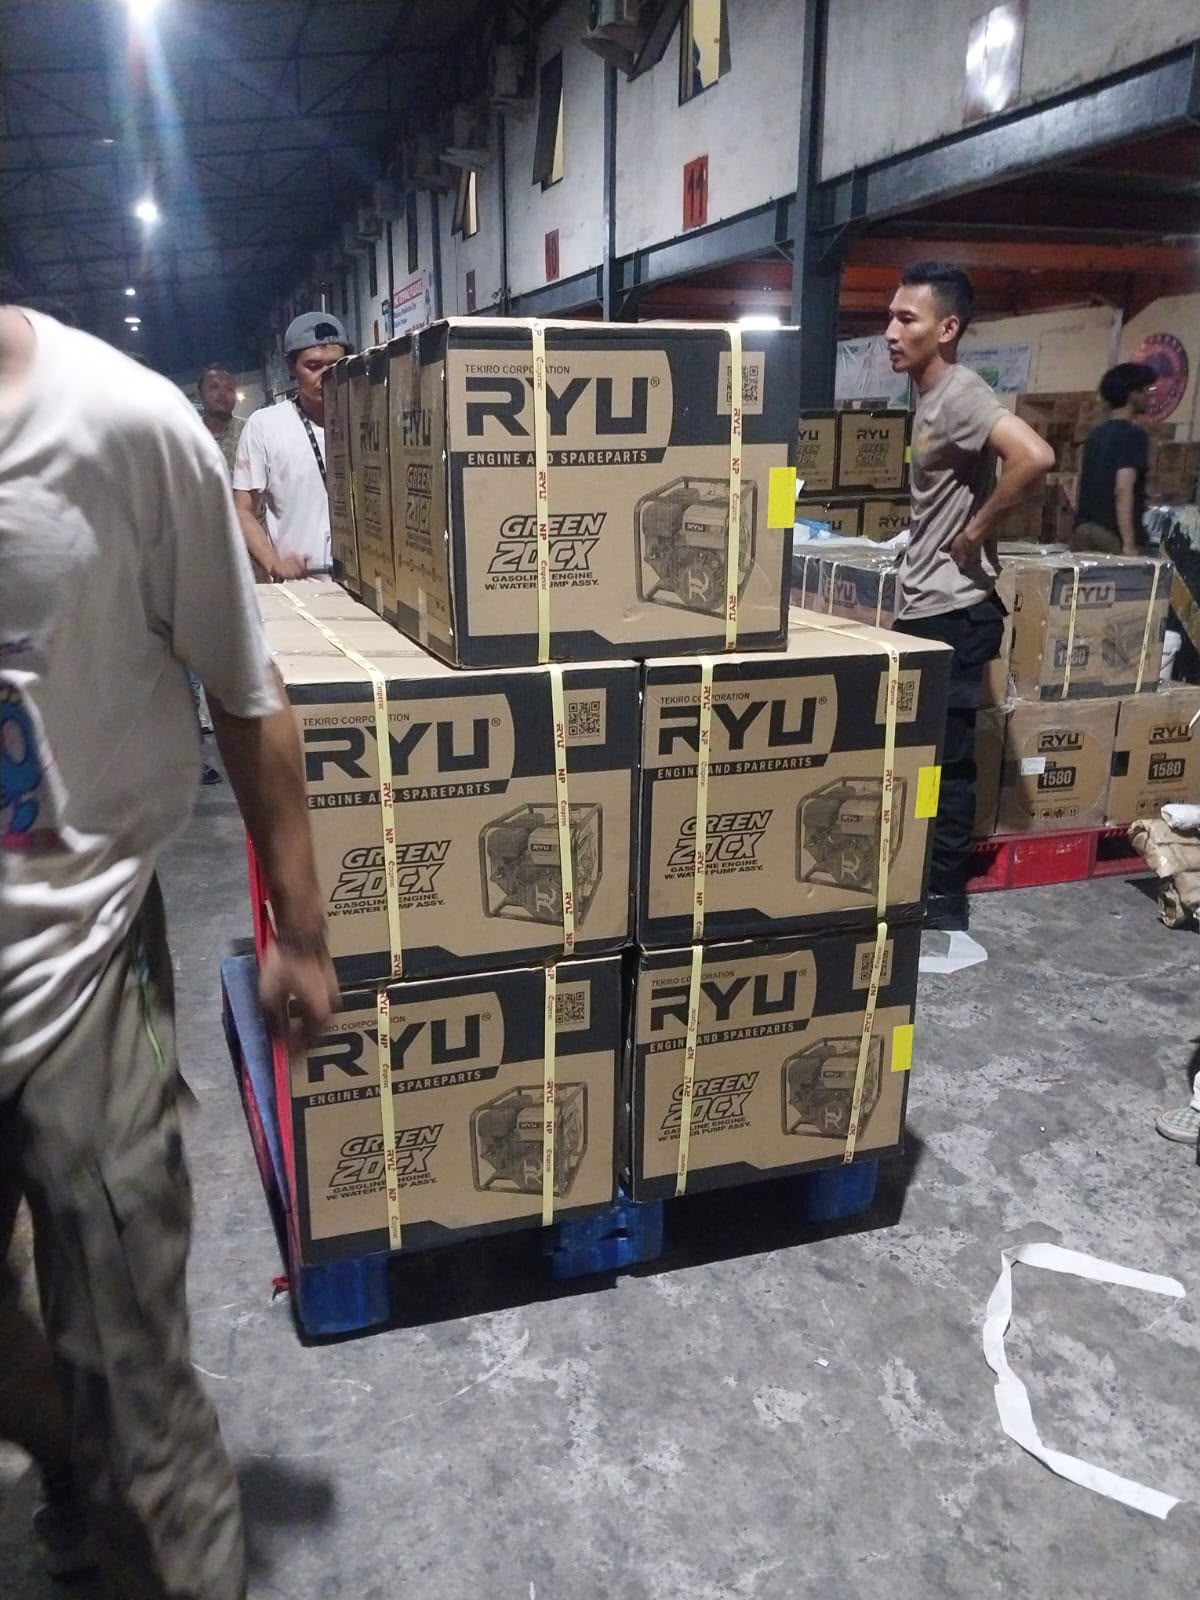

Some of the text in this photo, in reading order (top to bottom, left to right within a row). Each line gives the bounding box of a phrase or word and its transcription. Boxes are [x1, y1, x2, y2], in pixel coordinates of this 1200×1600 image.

[465, 364, 500, 374] TEKIRO
[857, 429, 889, 440] RYU
[467, 450, 647, 466] ENGINE AD SPAREPARTS
[551, 572, 593, 580] ENGINE
[499, 582, 537, 590] WATER
[660, 695, 690, 705] TEKIRO
[303, 713, 410, 727] TEKIRO CORPOTION
[1152, 725, 1189, 739] RYU
[1041, 732, 1080, 747] RYU
[736, 757, 812, 773] SPAREPARTS
[1153, 761, 1181, 777] 1580
[1043, 770, 1072, 786] 1580
[307, 783, 491, 808] ENGINE AD SPAREPARTS
[721, 859, 758, 868] ENGINE
[334, 900, 387, 909] GASOLIN
[342, 906, 381, 915] WATER
[650, 1039, 684, 1053] ENGIN
[724, 1022, 794, 1040] SPAREPARTS
[309, 1071, 481, 1106] ENGINE AN SPAREPARTS
